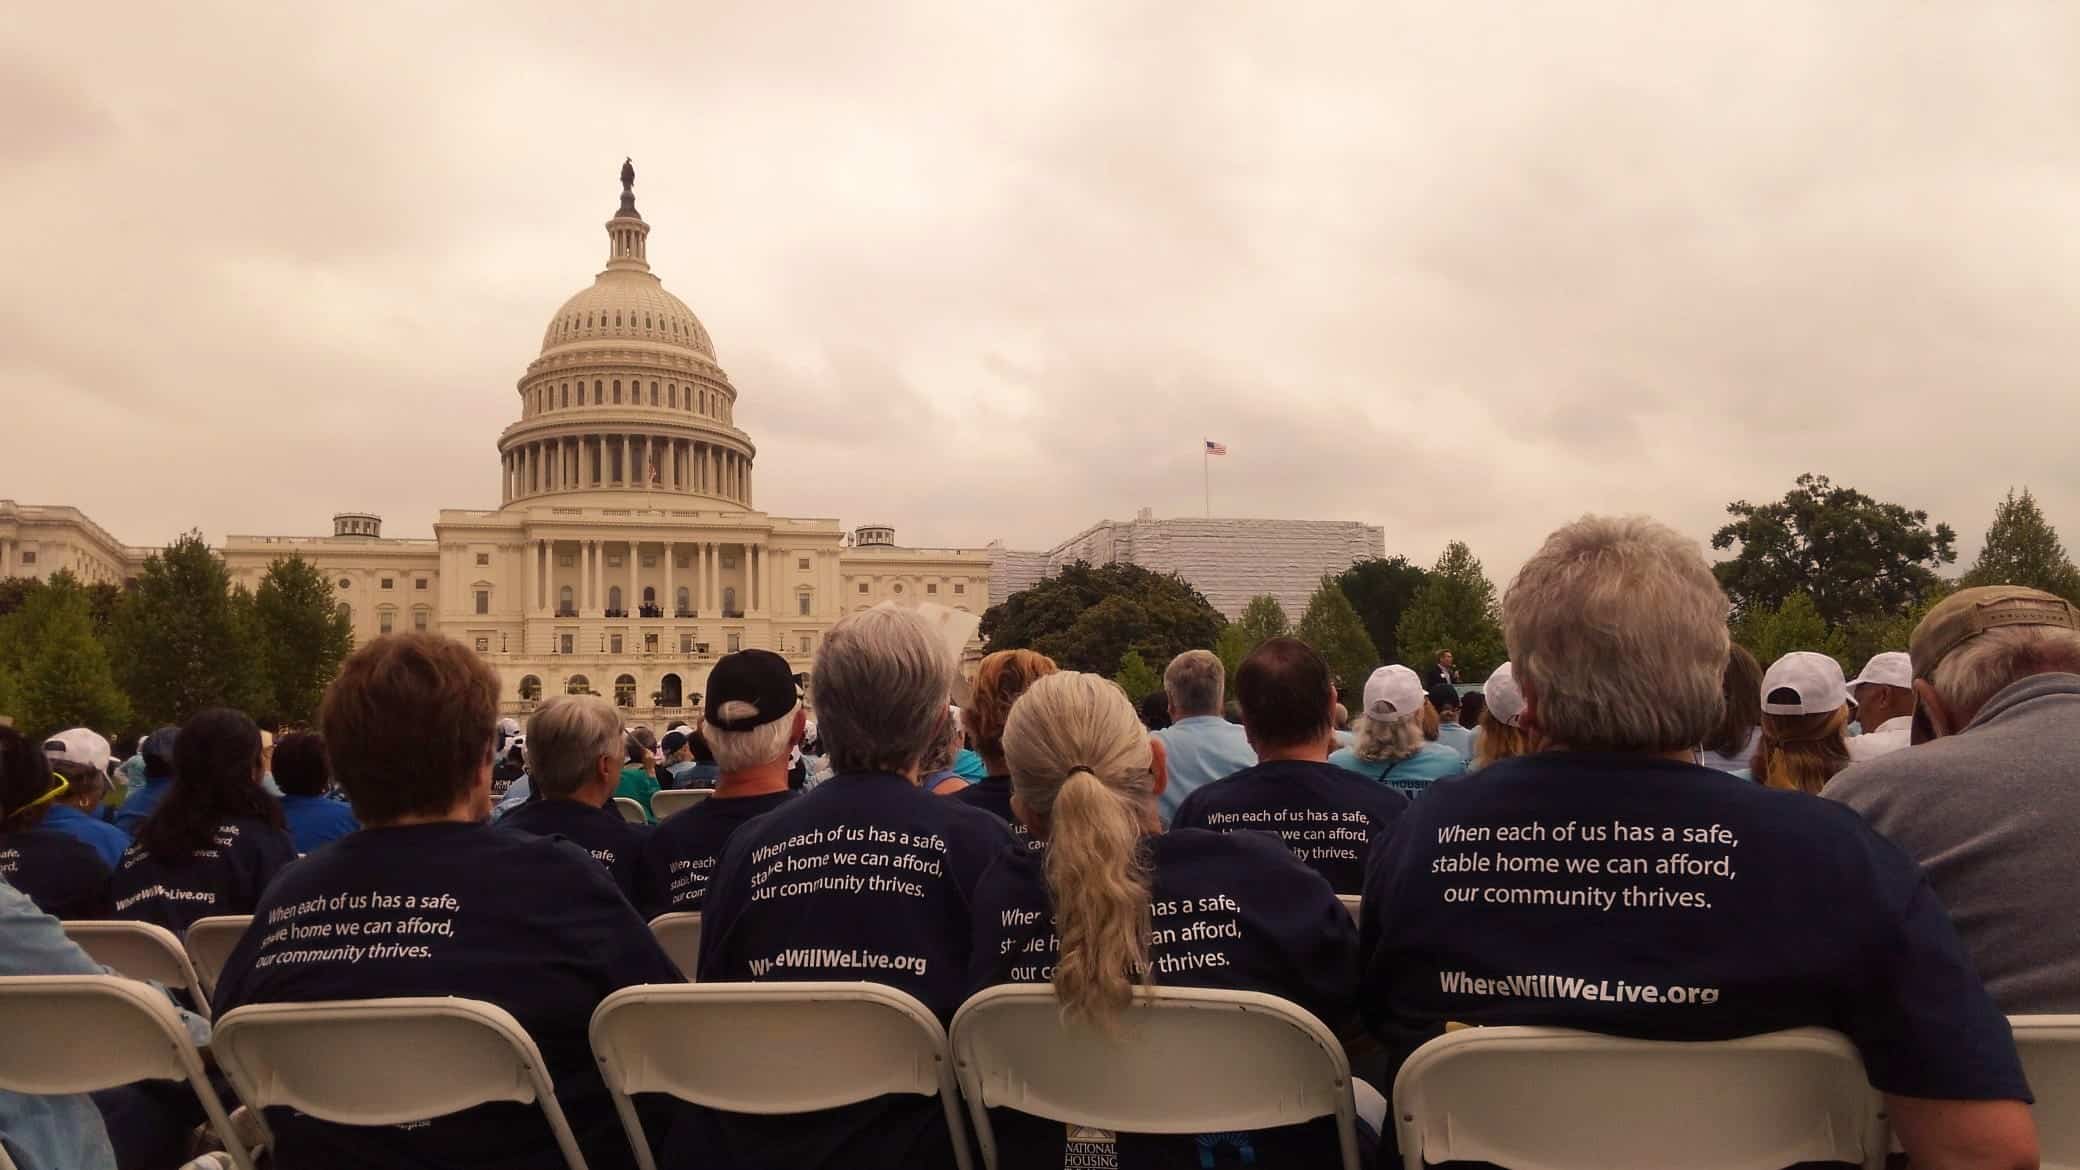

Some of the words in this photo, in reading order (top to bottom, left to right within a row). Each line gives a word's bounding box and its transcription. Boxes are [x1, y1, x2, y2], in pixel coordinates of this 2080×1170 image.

[1208, 812, 1239, 824] When
[1242, 810, 1270, 821] each
[1274, 809, 1287, 821] of
[1290, 812, 1303, 821] us
[1307, 809, 1328, 821] has
[1332, 813, 1338, 821] a
[1342, 811, 1369, 825] safe,
[1015, 823, 1029, 835] us
[1282, 831, 1300, 840] we
[1304, 831, 1325, 840] can
[1329, 827, 1368, 843] afford,
[1439, 825, 1490, 843] When
[1496, 821, 1545, 841] each
[1553, 821, 1576, 841] of
[1582, 826, 1606, 841] us
[1615, 821, 1654, 841] has
[1662, 828, 1674, 841] a
[1683, 824, 1738, 847] safe,
[591, 848, 616, 863] safe,
[752, 842, 786, 866] When
[788, 829, 823, 847] each
[827, 825, 844, 841] of
[847, 829, 864, 840] us
[869, 826, 896, 842] has
[900, 833, 908, 844] a
[913, 835, 947, 853] safe,
[1313, 847, 1357, 859] thrives.
[692, 855, 716, 870] each
[752, 859, 784, 889] stae
[788, 854, 829, 871] home
[833, 853, 856, 864] we
[861, 853, 888, 866] can
[893, 851, 945, 879] afford,
[1432, 852, 1490, 873] stable
[1496, 853, 1559, 872] home
[1566, 859, 1600, 873] we
[1607, 859, 1647, 873] can
[1656, 854, 1735, 880] afford,
[780, 874, 865, 896] community
[869, 875, 924, 897] thrives.
[269, 906, 296, 926] When
[298, 895, 326, 915] each
[330, 892, 348, 910] of
[349, 896, 367, 909] us
[372, 891, 401, 908] has
[405, 896, 415, 908] a
[420, 894, 460, 912] safe,
[1182, 898, 1193, 914] a
[1198, 893, 1241, 913] safe,
[1444, 888, 1479, 902] our
[1484, 887, 1615, 911] community
[1622, 886, 1711, 908] thrives.
[291, 923, 332, 939] home
[336, 923, 359, 935] we
[364, 922, 392, 934] can
[397, 917, 454, 937] afford,
[999, 935, 1045, 955] stle
[1181, 918, 1242, 942] afford,
[275, 945, 366, 963] community
[369, 943, 431, 958] thrives.
[749, 949, 926, 976] WeWillWeLive.org
[1011, 965, 1036, 980] our
[1158, 951, 1231, 974] thrives.
[1440, 972, 1718, 1004] WhereWillWeLive.org
[1064, 1143, 1116, 1154] NATIONAL
[1064, 1155, 1119, 1168] HOUSING
